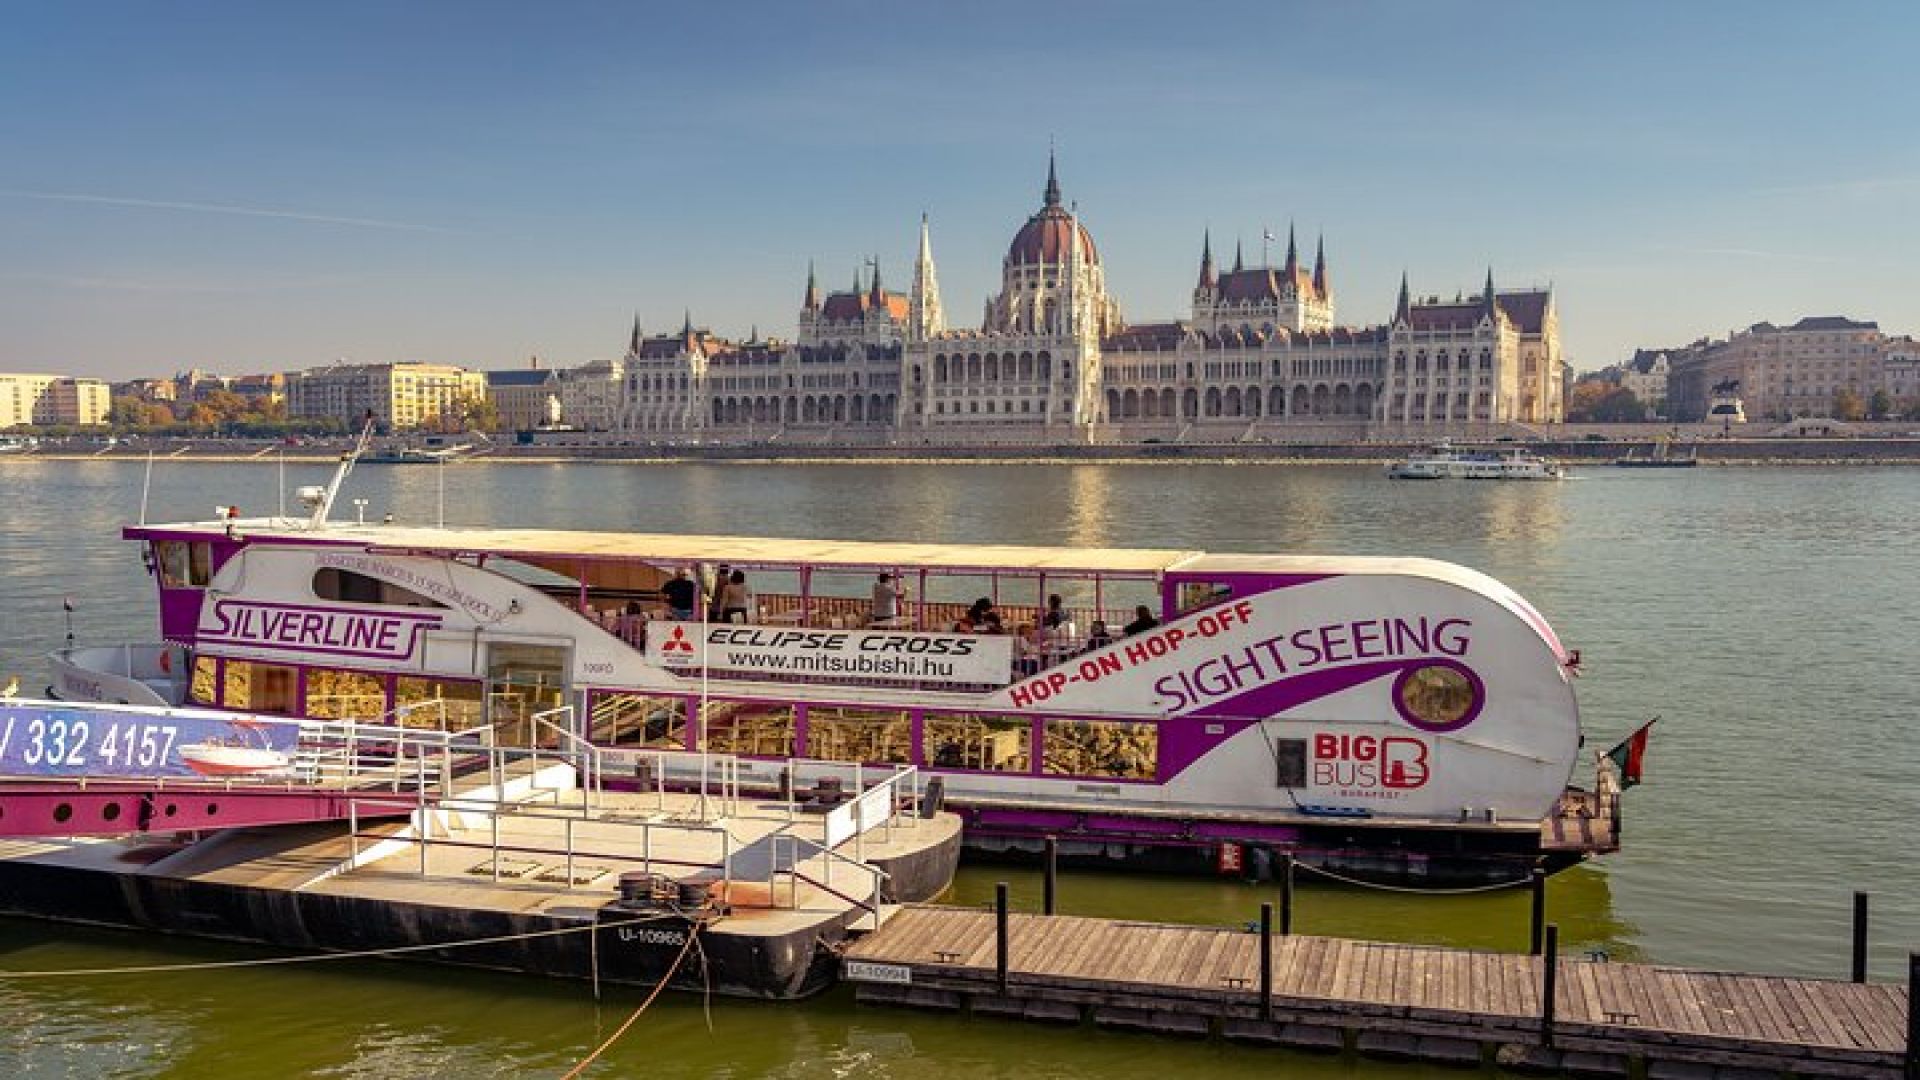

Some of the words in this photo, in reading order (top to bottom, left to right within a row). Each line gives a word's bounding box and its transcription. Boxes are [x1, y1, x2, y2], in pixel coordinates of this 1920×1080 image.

[216, 600, 401, 651] SILVERLINE
[708, 629, 849, 649] ECLIPSE
[860, 635, 977, 655] CROSS
[728, 652, 953, 676] www.mitsubishi.hu
[1008, 651, 1123, 708] HOP-ON
[1124, 601, 1254, 666] HOP-OFF
[1154, 616, 1473, 713] SIGHTSEEING
[24, 719, 89, 766] 332
[99, 723, 177, 767] 4157
[1314, 733, 1377, 761] BIG
[1314, 762, 1377, 788] BUS
